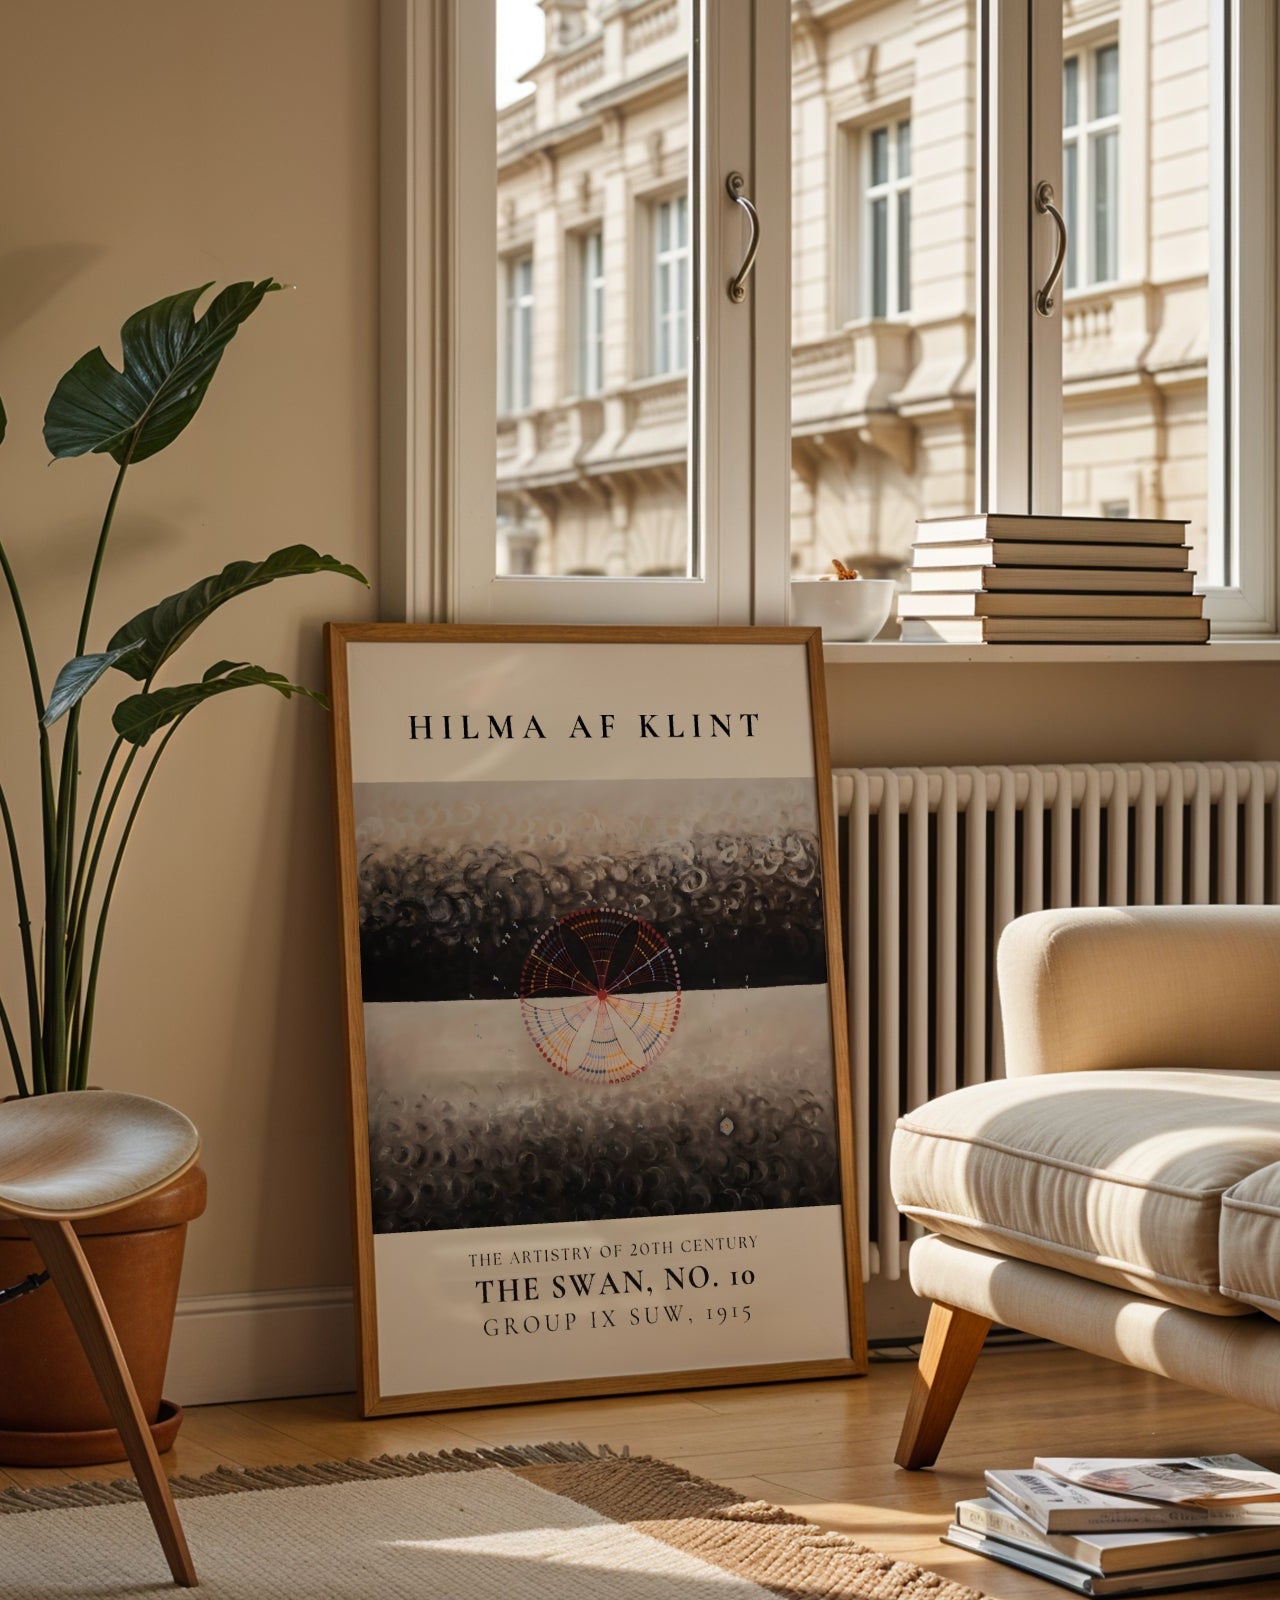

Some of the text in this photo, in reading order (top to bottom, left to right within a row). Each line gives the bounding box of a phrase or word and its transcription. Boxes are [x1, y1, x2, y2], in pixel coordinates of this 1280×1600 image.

[408, 713, 759, 739] HILMA AF KLINT
[468, 1235, 758, 1267] THE ARTISTRY OF 20TH CENTURY
[475, 1265, 755, 1304] THE SWAN, NO. 10
[483, 1305, 751, 1337] GROUP IX SUW, 1915
